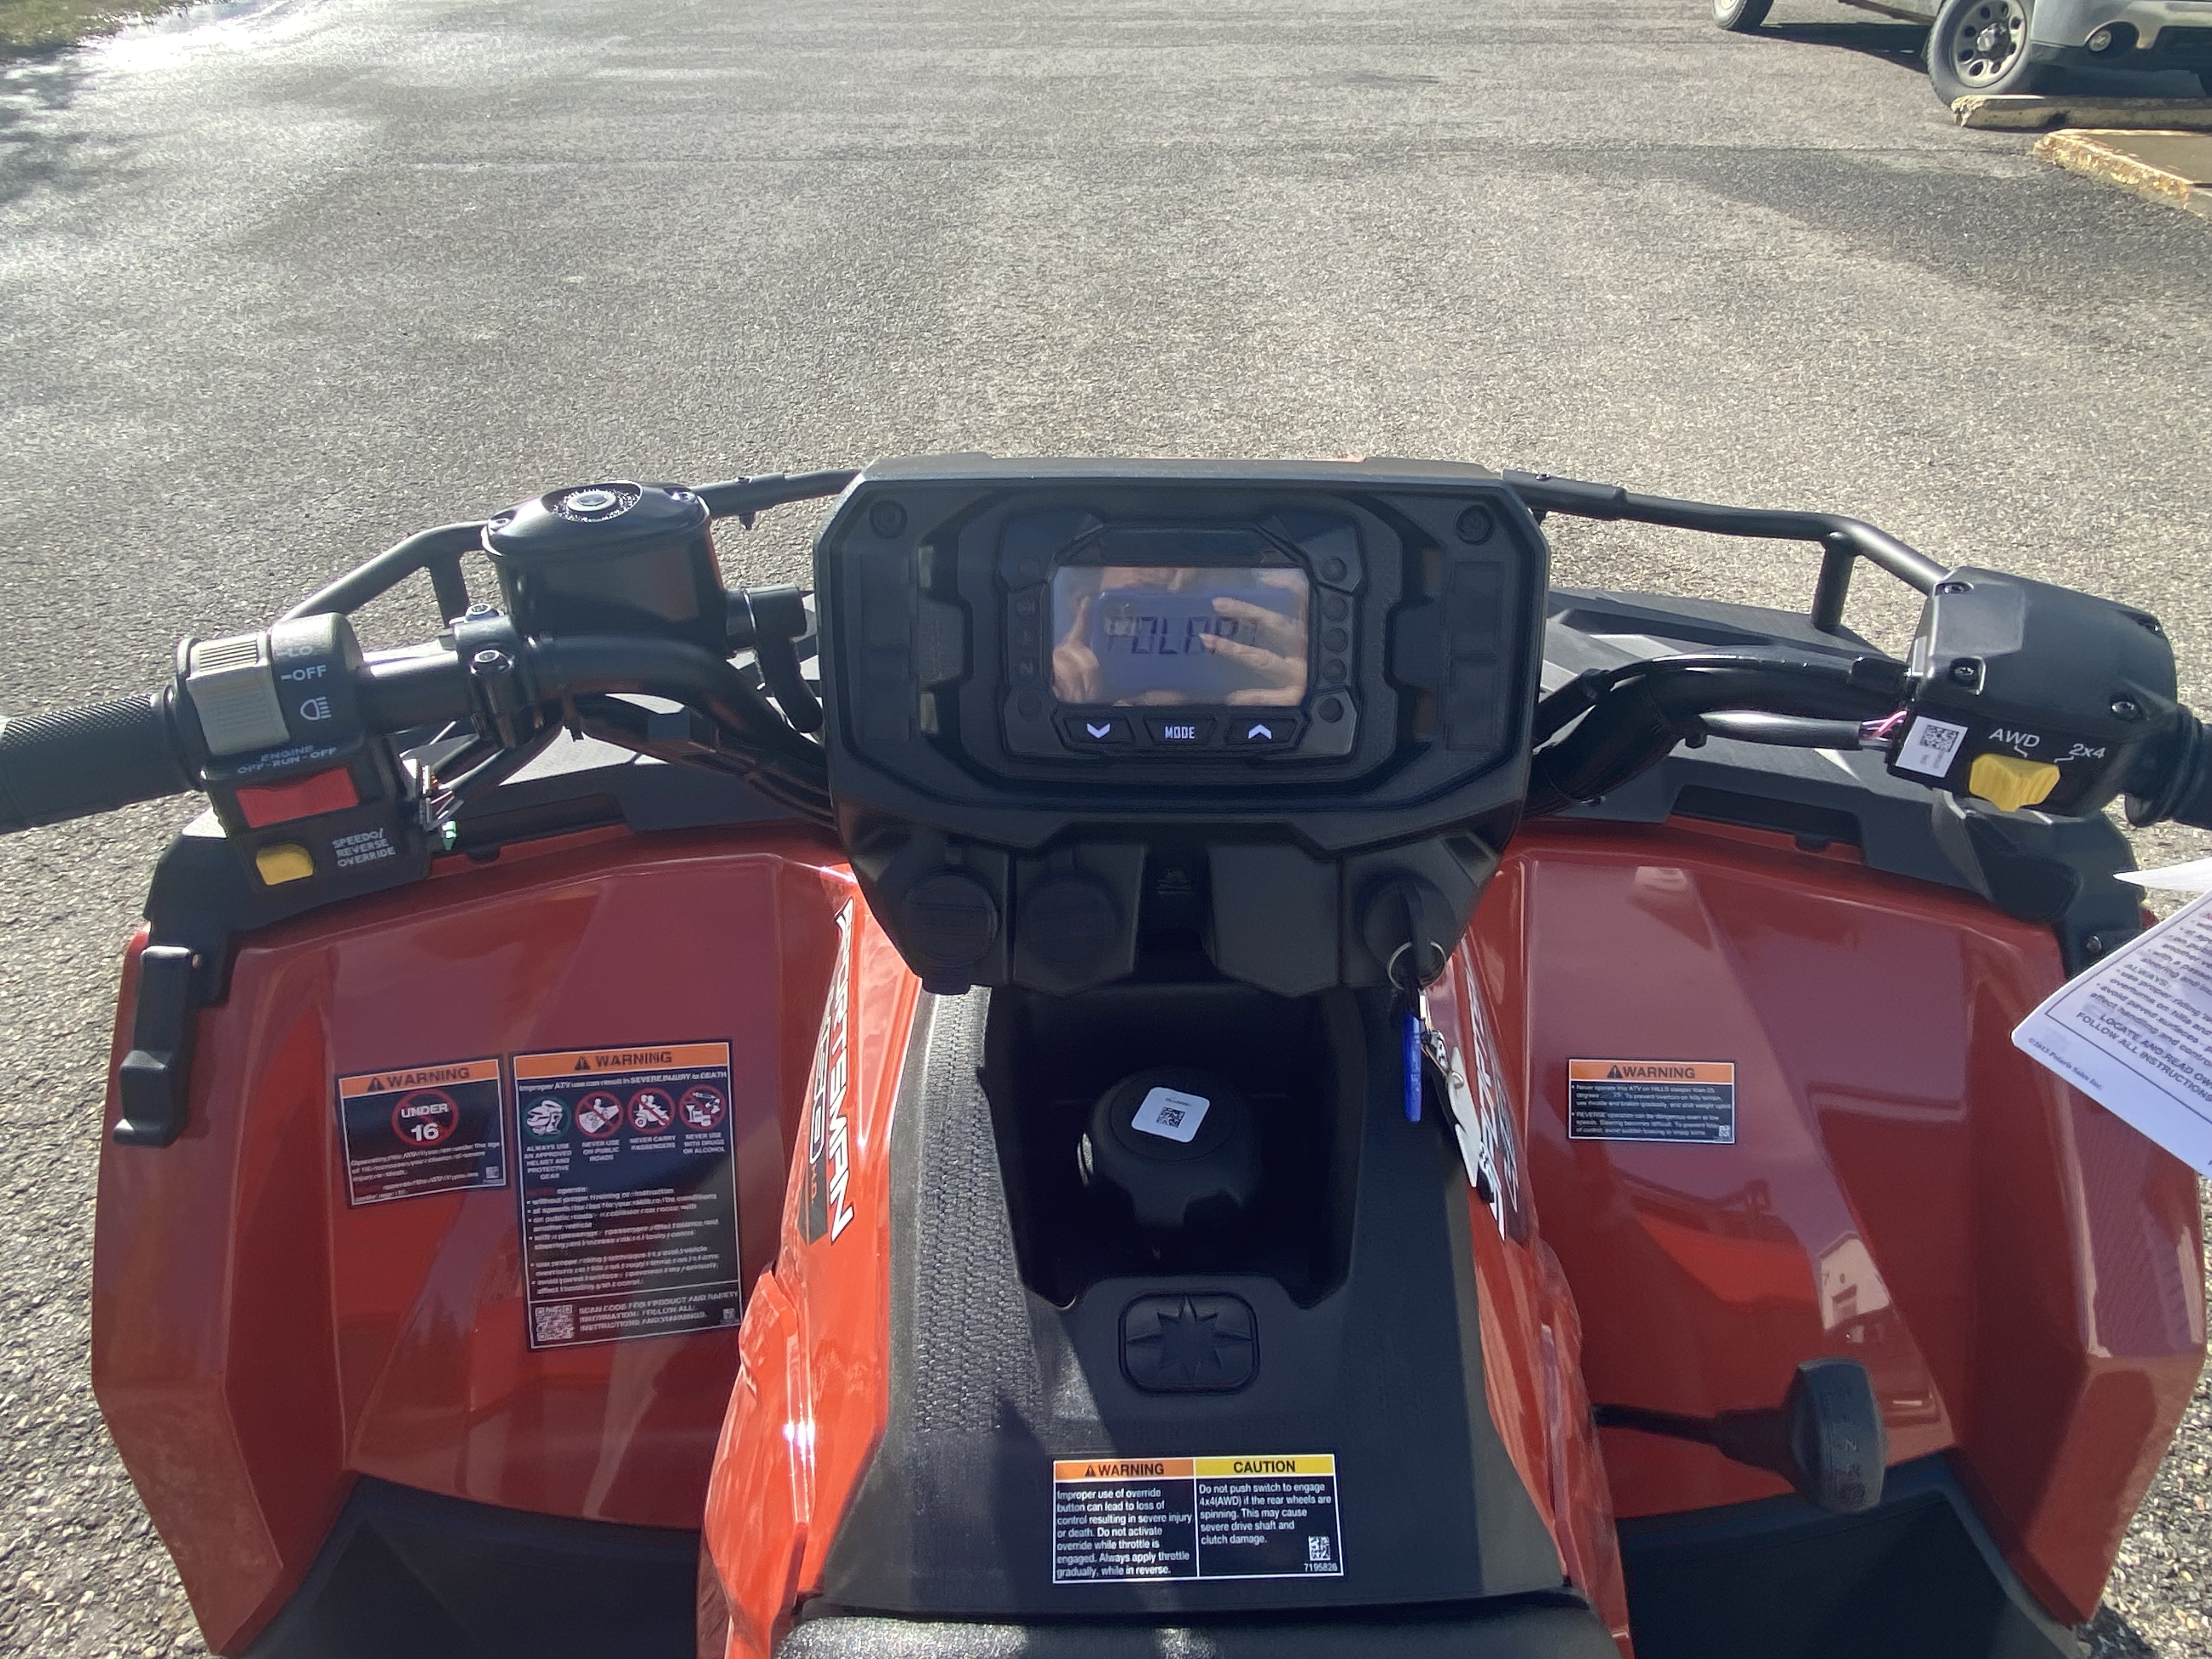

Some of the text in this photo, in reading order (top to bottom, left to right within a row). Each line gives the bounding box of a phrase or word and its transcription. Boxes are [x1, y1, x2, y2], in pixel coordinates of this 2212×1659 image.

[1165, 725, 1195, 739] MODE
[1988, 728, 2040, 747] AWD
[261, 744, 314, 762] ENGINE
[2068, 743, 2106, 759] 2x4
[335, 838, 390, 858] REVERSE
[337, 846, 396, 867] OVERRIDE
[2077, 1012, 2120, 1040] FOLLOW
[2117, 1037, 2139, 1054] ALL
[2099, 1014, 2140, 1041] LOCATE
[2140, 1039, 2165, 1056] AND
[2164, 1051, 2194, 1075] READ
[595, 1051, 672, 1067] WARNING
[386, 1066, 470, 1088] WARNING
[830, 898, 854, 1243] SPORTSMAN
[1622, 1066, 1695, 1078] WARNING
[400, 1103, 448, 1118] UNDER
[410, 1121, 439, 1142] 16
[1098, 1464, 1164, 1476] WARNING
[1233, 1460, 1296, 1473] CAUTION
[1057, 1489, 1096, 1500] Improper
[1115, 1489, 1124, 1497] of
[1126, 1488, 1161, 1497] override
[1199, 1482, 1325, 1495] Do not push switch to engage
[1057, 1503, 1085, 1513] button
[1104, 1502, 1123, 1510] lead
[1136, 1500, 1154, 1510] loss
[1156, 1500, 1165, 1509] of
[1199, 1496, 1242, 1507] 4x4(AWD)
[1243, 1496, 1249, 1505] if
[1250, 1495, 1265, 1505] the
[1285, 1494, 1316, 1504] wheels
[1057, 1512, 1192, 1526] control resulting in severe injury
[1199, 1510, 1238, 1521] spinning.
[1240, 1509, 1259, 1517] This
[1261, 1510, 1279, 1520] may
[1068, 1528, 1095, 1537] death.
[1097, 1527, 1109, 1537] Do
[1111, 1527, 1126, 1536] not
[1128, 1526, 1163, 1536] activate
[1200, 1520, 1295, 1532] severe drive shaft and
[1057, 1539, 1159, 1550] override while throttle is
[1201, 1534, 1267, 1545] clutch damage.
[1057, 1551, 1189, 1566] engaged. Always apply throttle
[1057, 1566, 1171, 1579] gradually, while in reverse.
